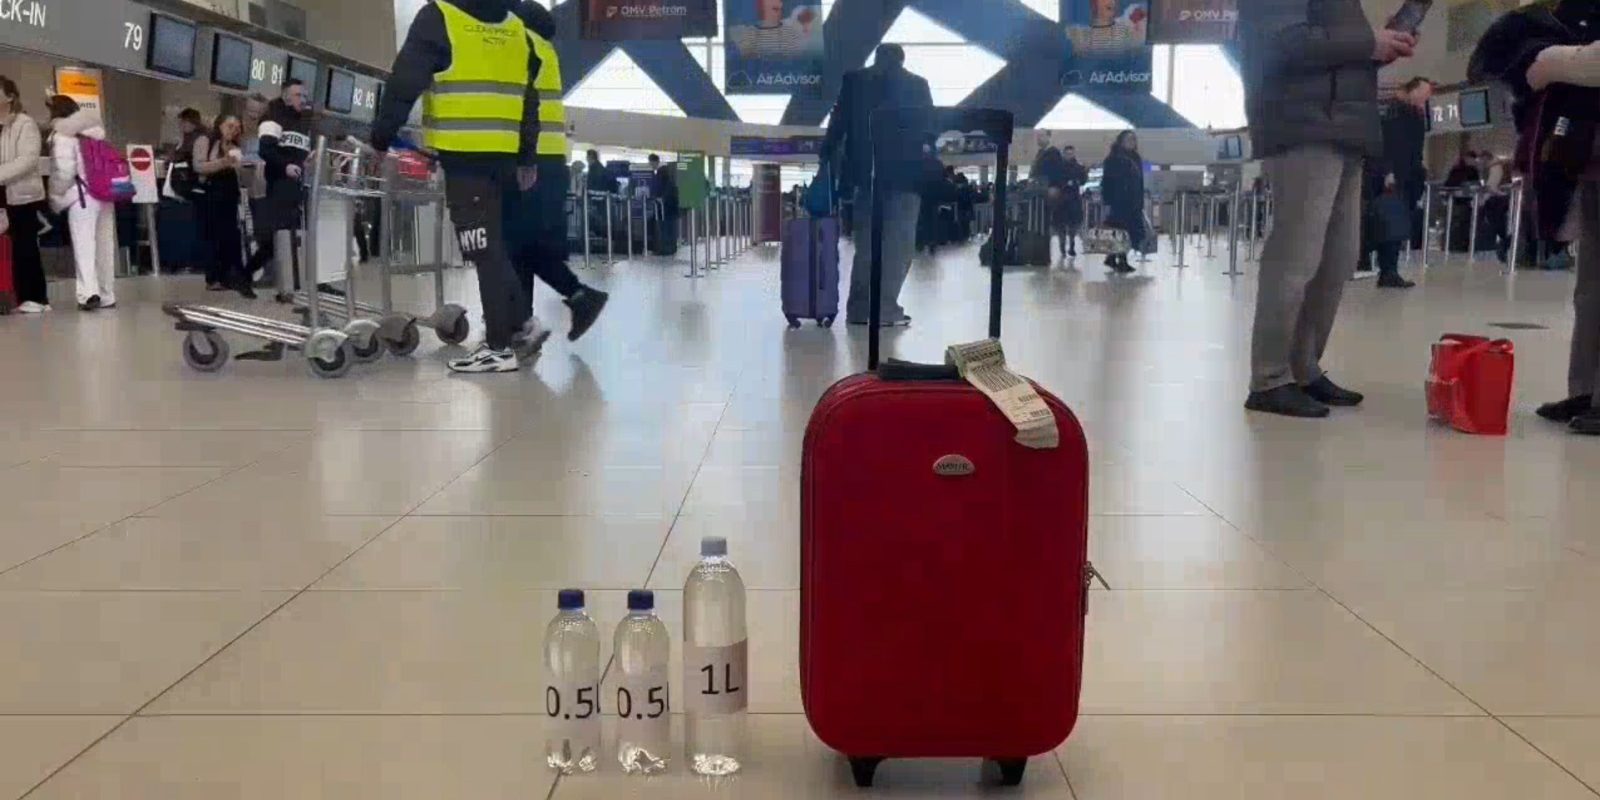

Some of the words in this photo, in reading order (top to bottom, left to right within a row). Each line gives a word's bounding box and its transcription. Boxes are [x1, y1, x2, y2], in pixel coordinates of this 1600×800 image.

[620, 5, 646, 16] OMV
[648, 5, 688, 16] Petrom
[124, 22, 143, 51] 79
[251, 59, 265, 81] 80
[271, 64, 284, 86] 81
[756, 72, 822, 85] AirAdvisor
[1088, 71, 1151, 84] AirAdvisor
[353, 88, 363, 106] 82
[701, 663, 740, 694] 1L
